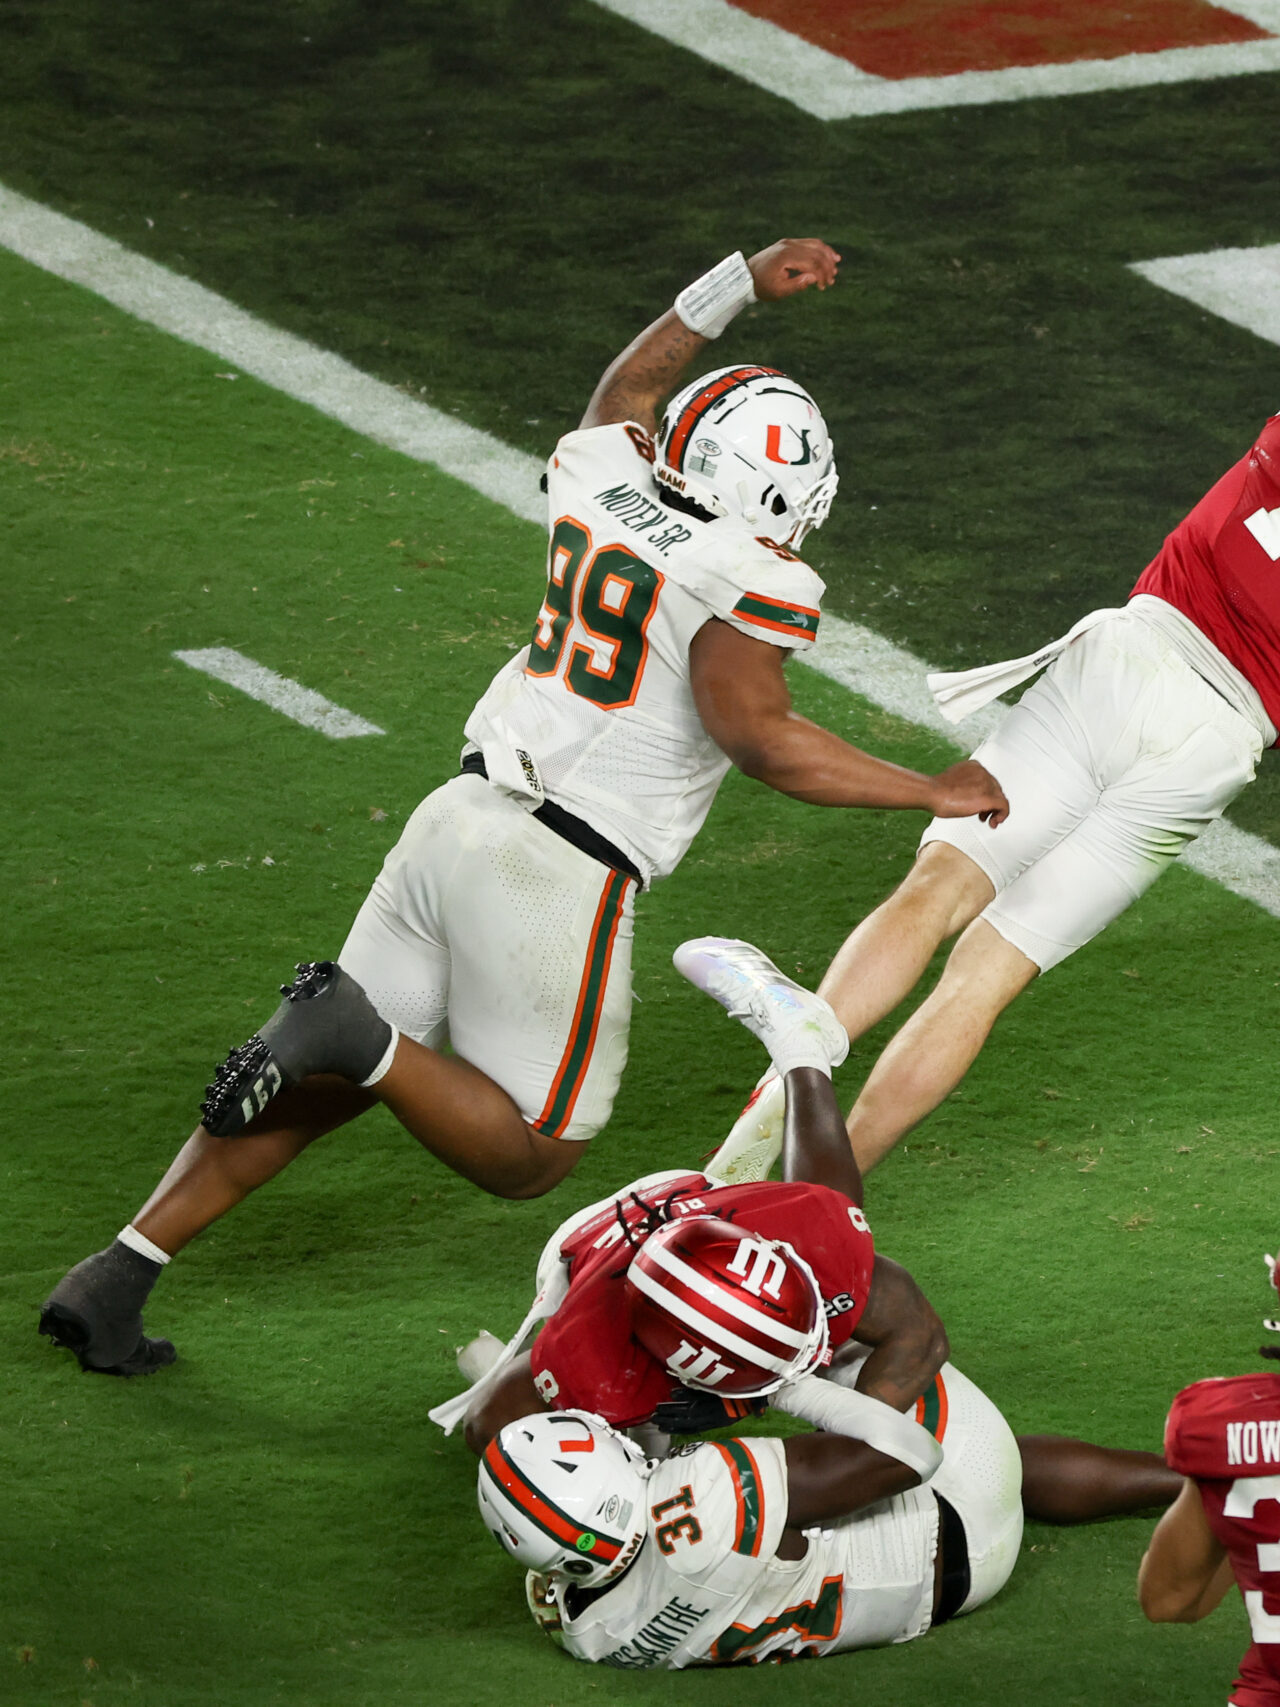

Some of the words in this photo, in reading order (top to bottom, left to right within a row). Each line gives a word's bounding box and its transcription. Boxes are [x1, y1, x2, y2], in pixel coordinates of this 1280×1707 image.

[657, 468, 686, 491] MIAMI
[594, 483, 668, 532] MOTEN
[648, 523, 692, 557] SR.
[525, 515, 665, 711] 99
[603, 1533, 643, 1579] MIAMI
[652, 1484, 703, 1556] 31
